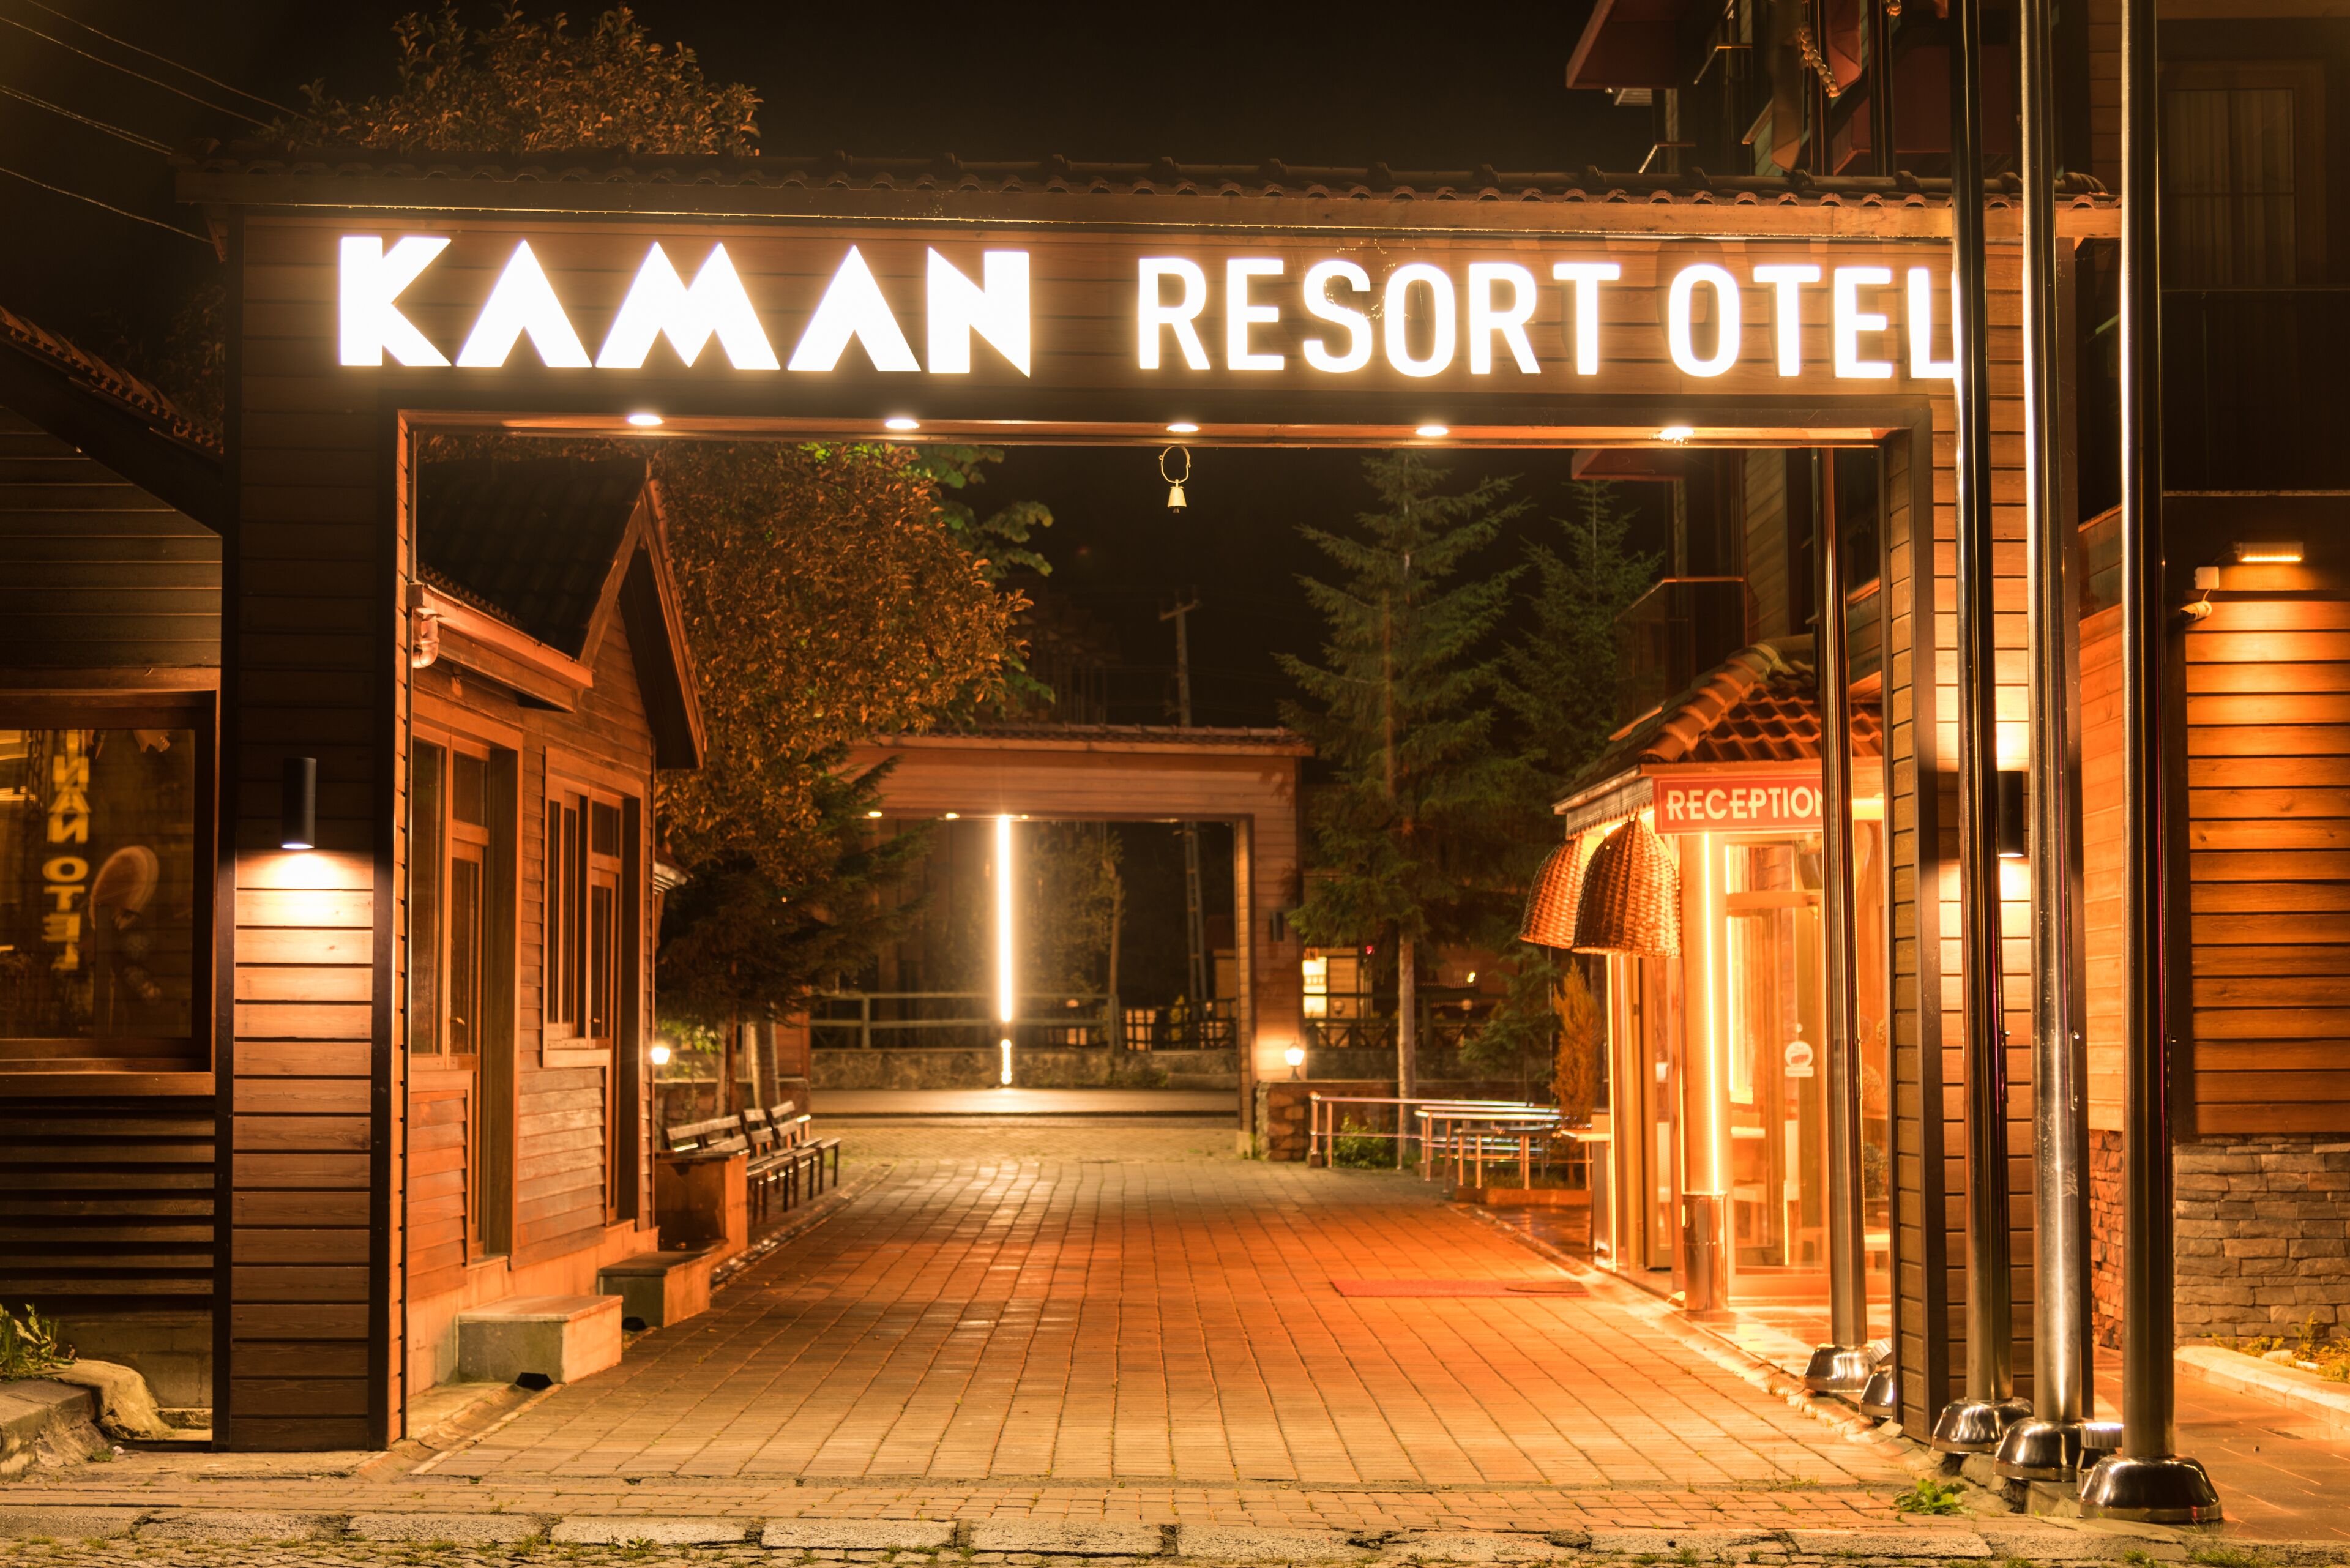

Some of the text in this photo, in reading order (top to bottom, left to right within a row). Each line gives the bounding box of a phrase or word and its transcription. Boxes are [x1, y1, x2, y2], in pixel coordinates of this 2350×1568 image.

[339, 236, 1955, 379] KAMAN RESORT OTEL
